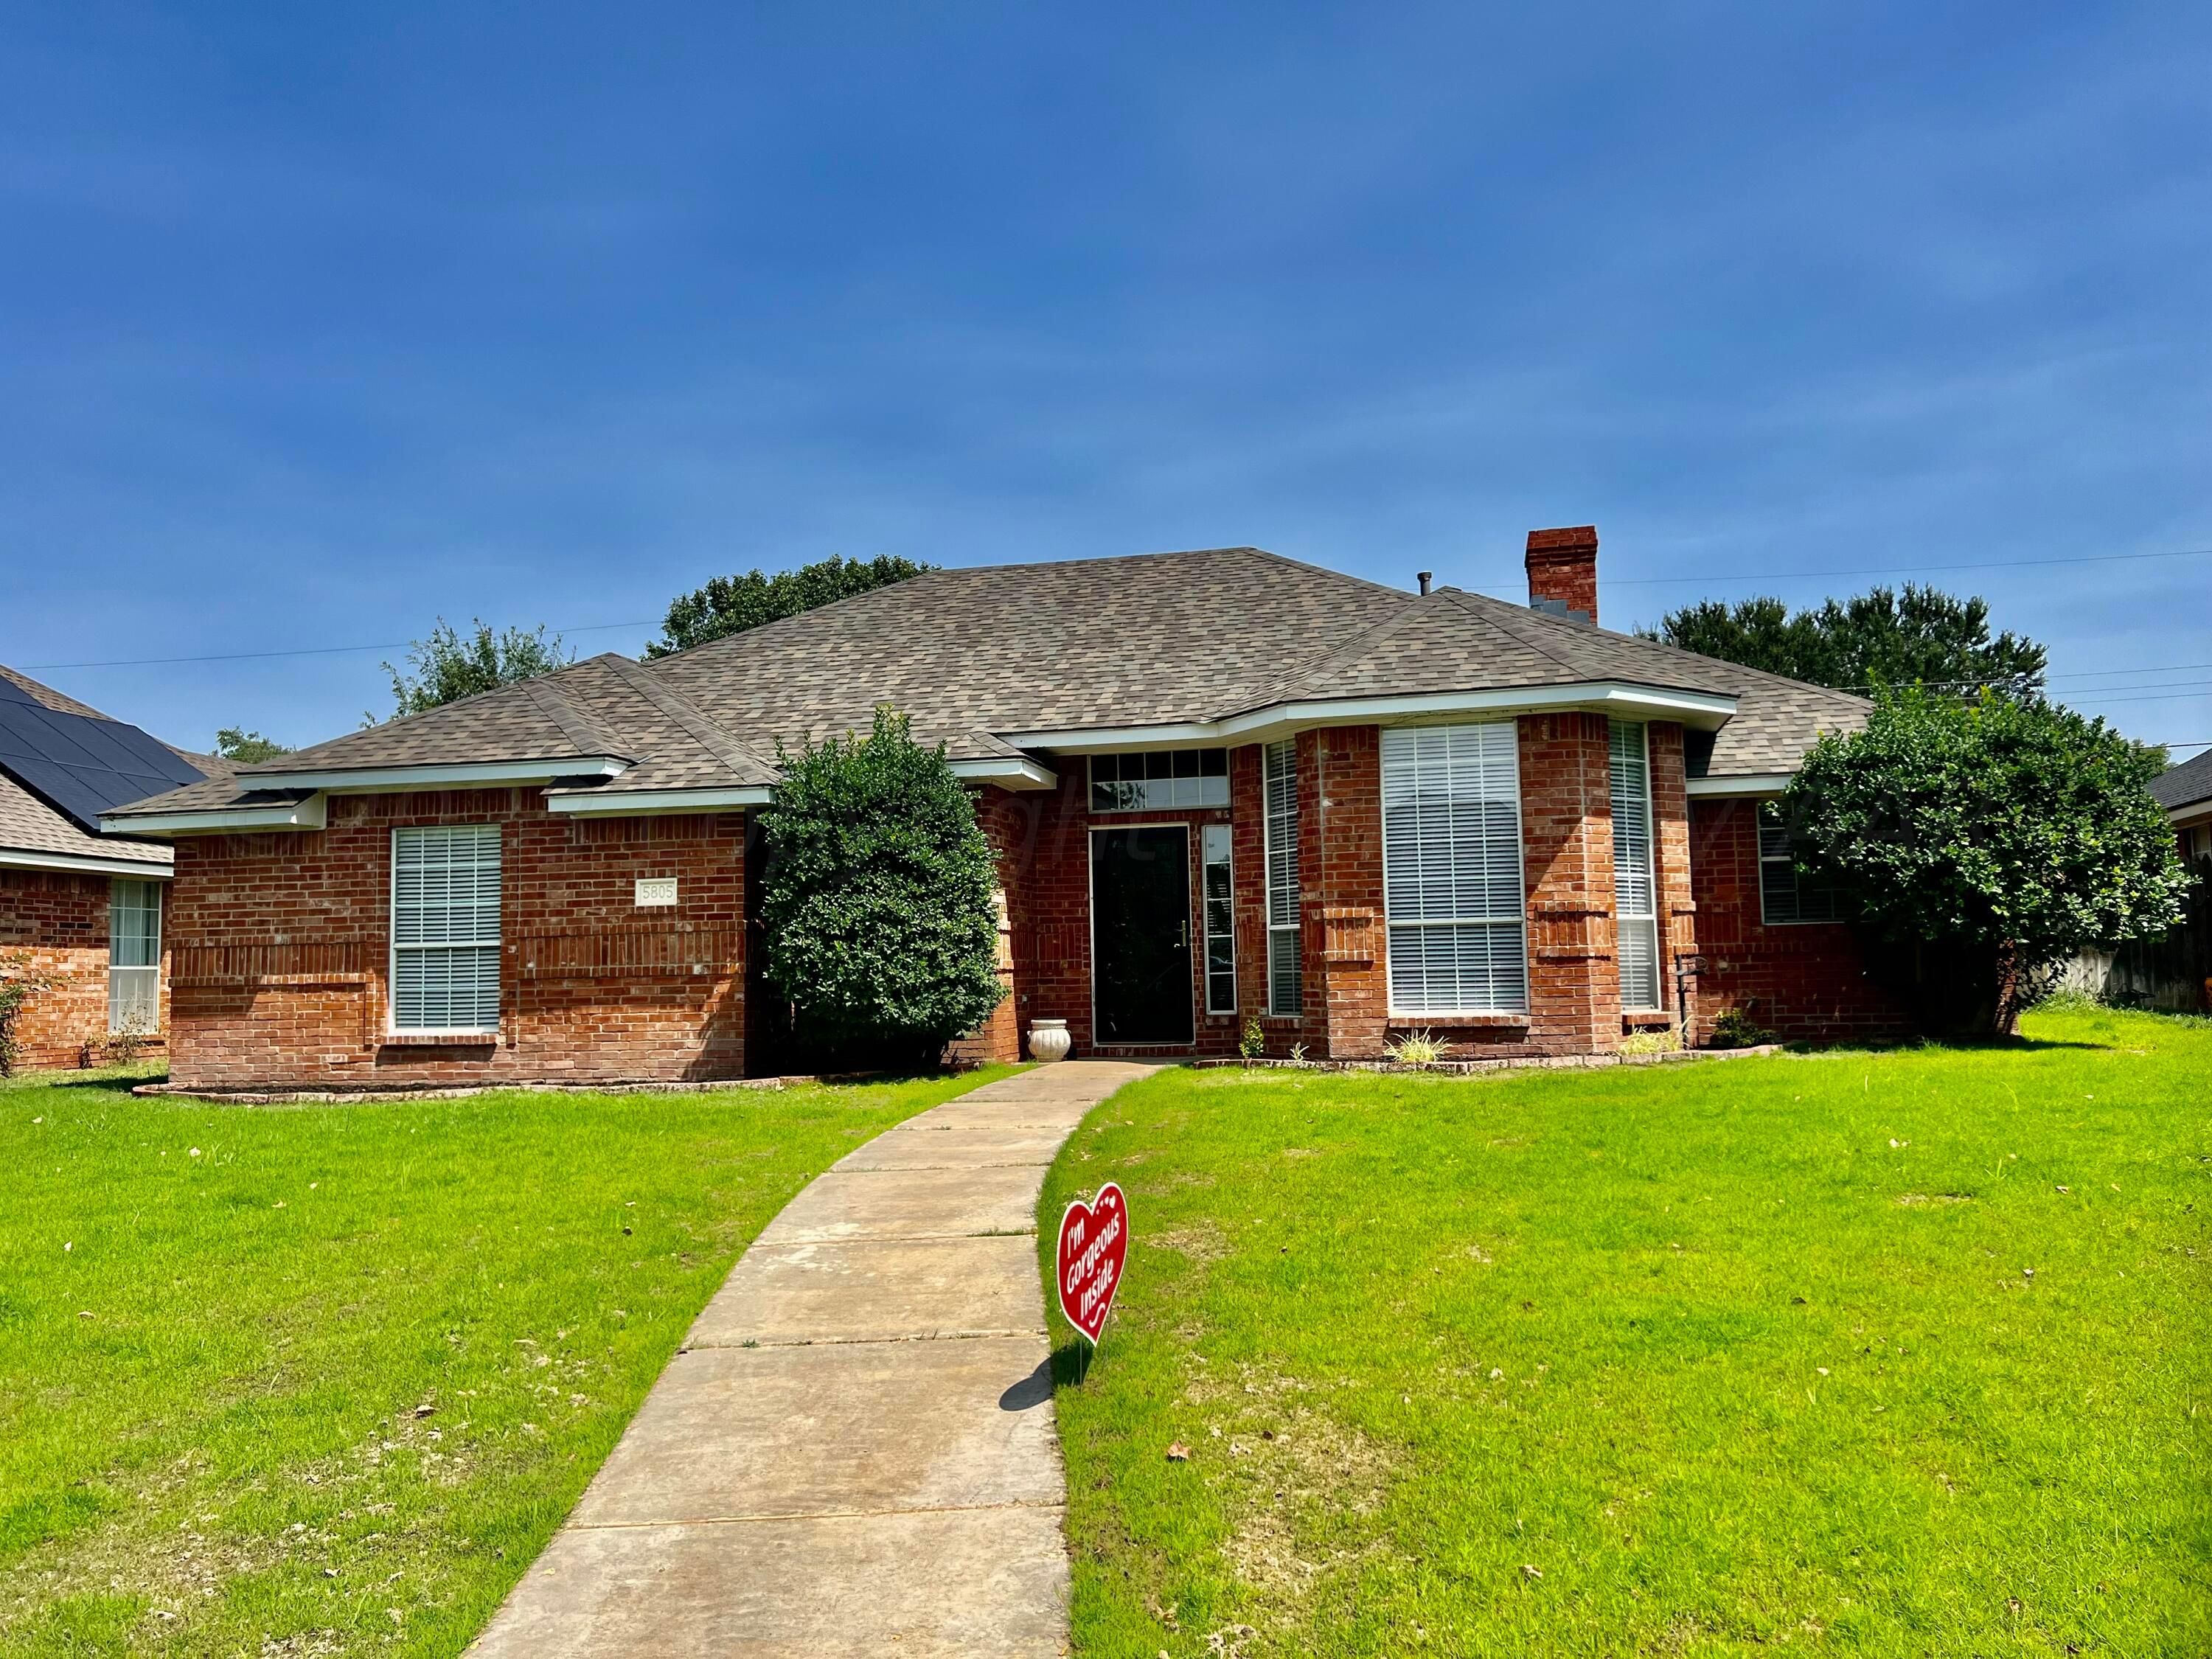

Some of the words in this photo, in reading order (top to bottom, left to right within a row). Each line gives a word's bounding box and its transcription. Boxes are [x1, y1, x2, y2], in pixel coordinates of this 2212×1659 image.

[643, 885, 673, 899] 5805
[1066, 1211, 1119, 1295] Gorgeous
[1067, 1217, 1085, 1259] I'm
[1080, 1258, 1114, 1321] Inside
